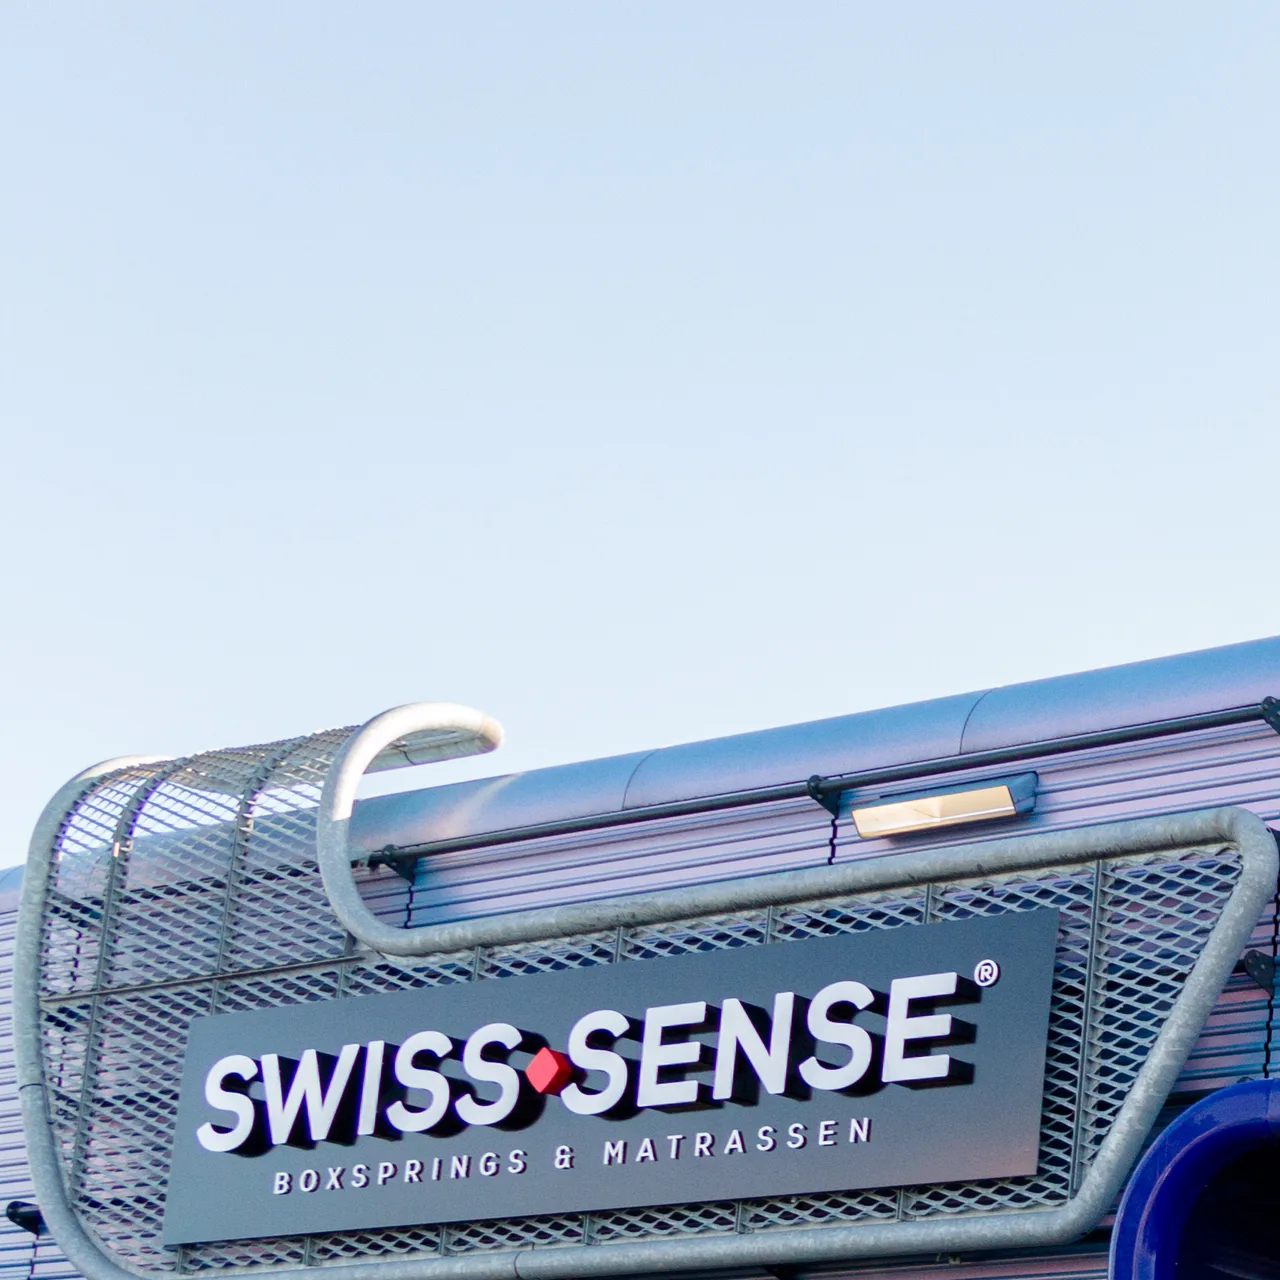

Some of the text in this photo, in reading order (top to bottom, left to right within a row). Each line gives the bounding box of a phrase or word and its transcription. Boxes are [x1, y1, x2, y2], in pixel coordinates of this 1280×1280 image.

[196, 1022, 523, 1154] SWISS
[272, 1116, 875, 1196] BOXSPRINGS & MATRASSEN
